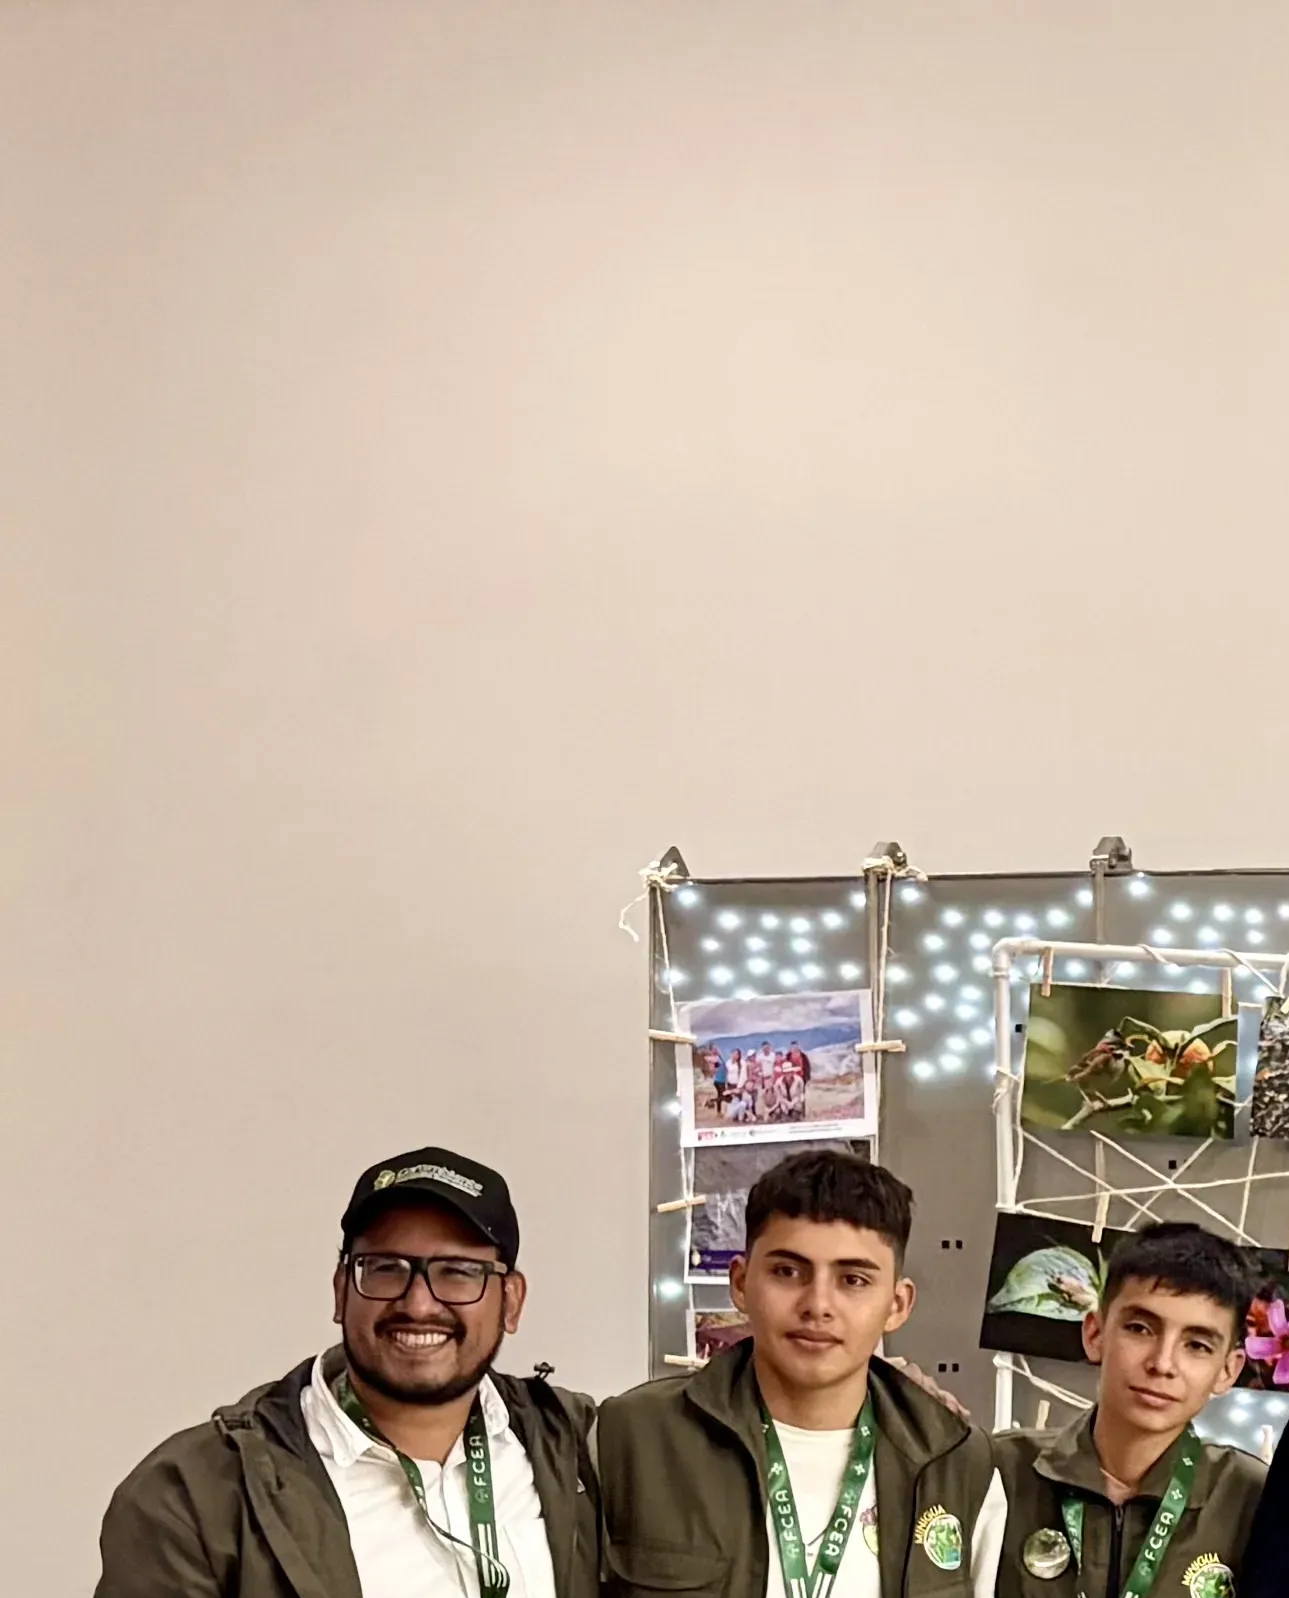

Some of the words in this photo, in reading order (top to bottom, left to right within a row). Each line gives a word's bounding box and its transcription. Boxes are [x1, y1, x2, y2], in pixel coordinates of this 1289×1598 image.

[469, 1435, 487, 1487] FCEA
[775, 1490, 798, 1541] FCEA
[825, 1505, 852, 1556] FCEA
[914, 1504, 947, 1544] MINIGUA
[1144, 1511, 1174, 1561] FCEA
